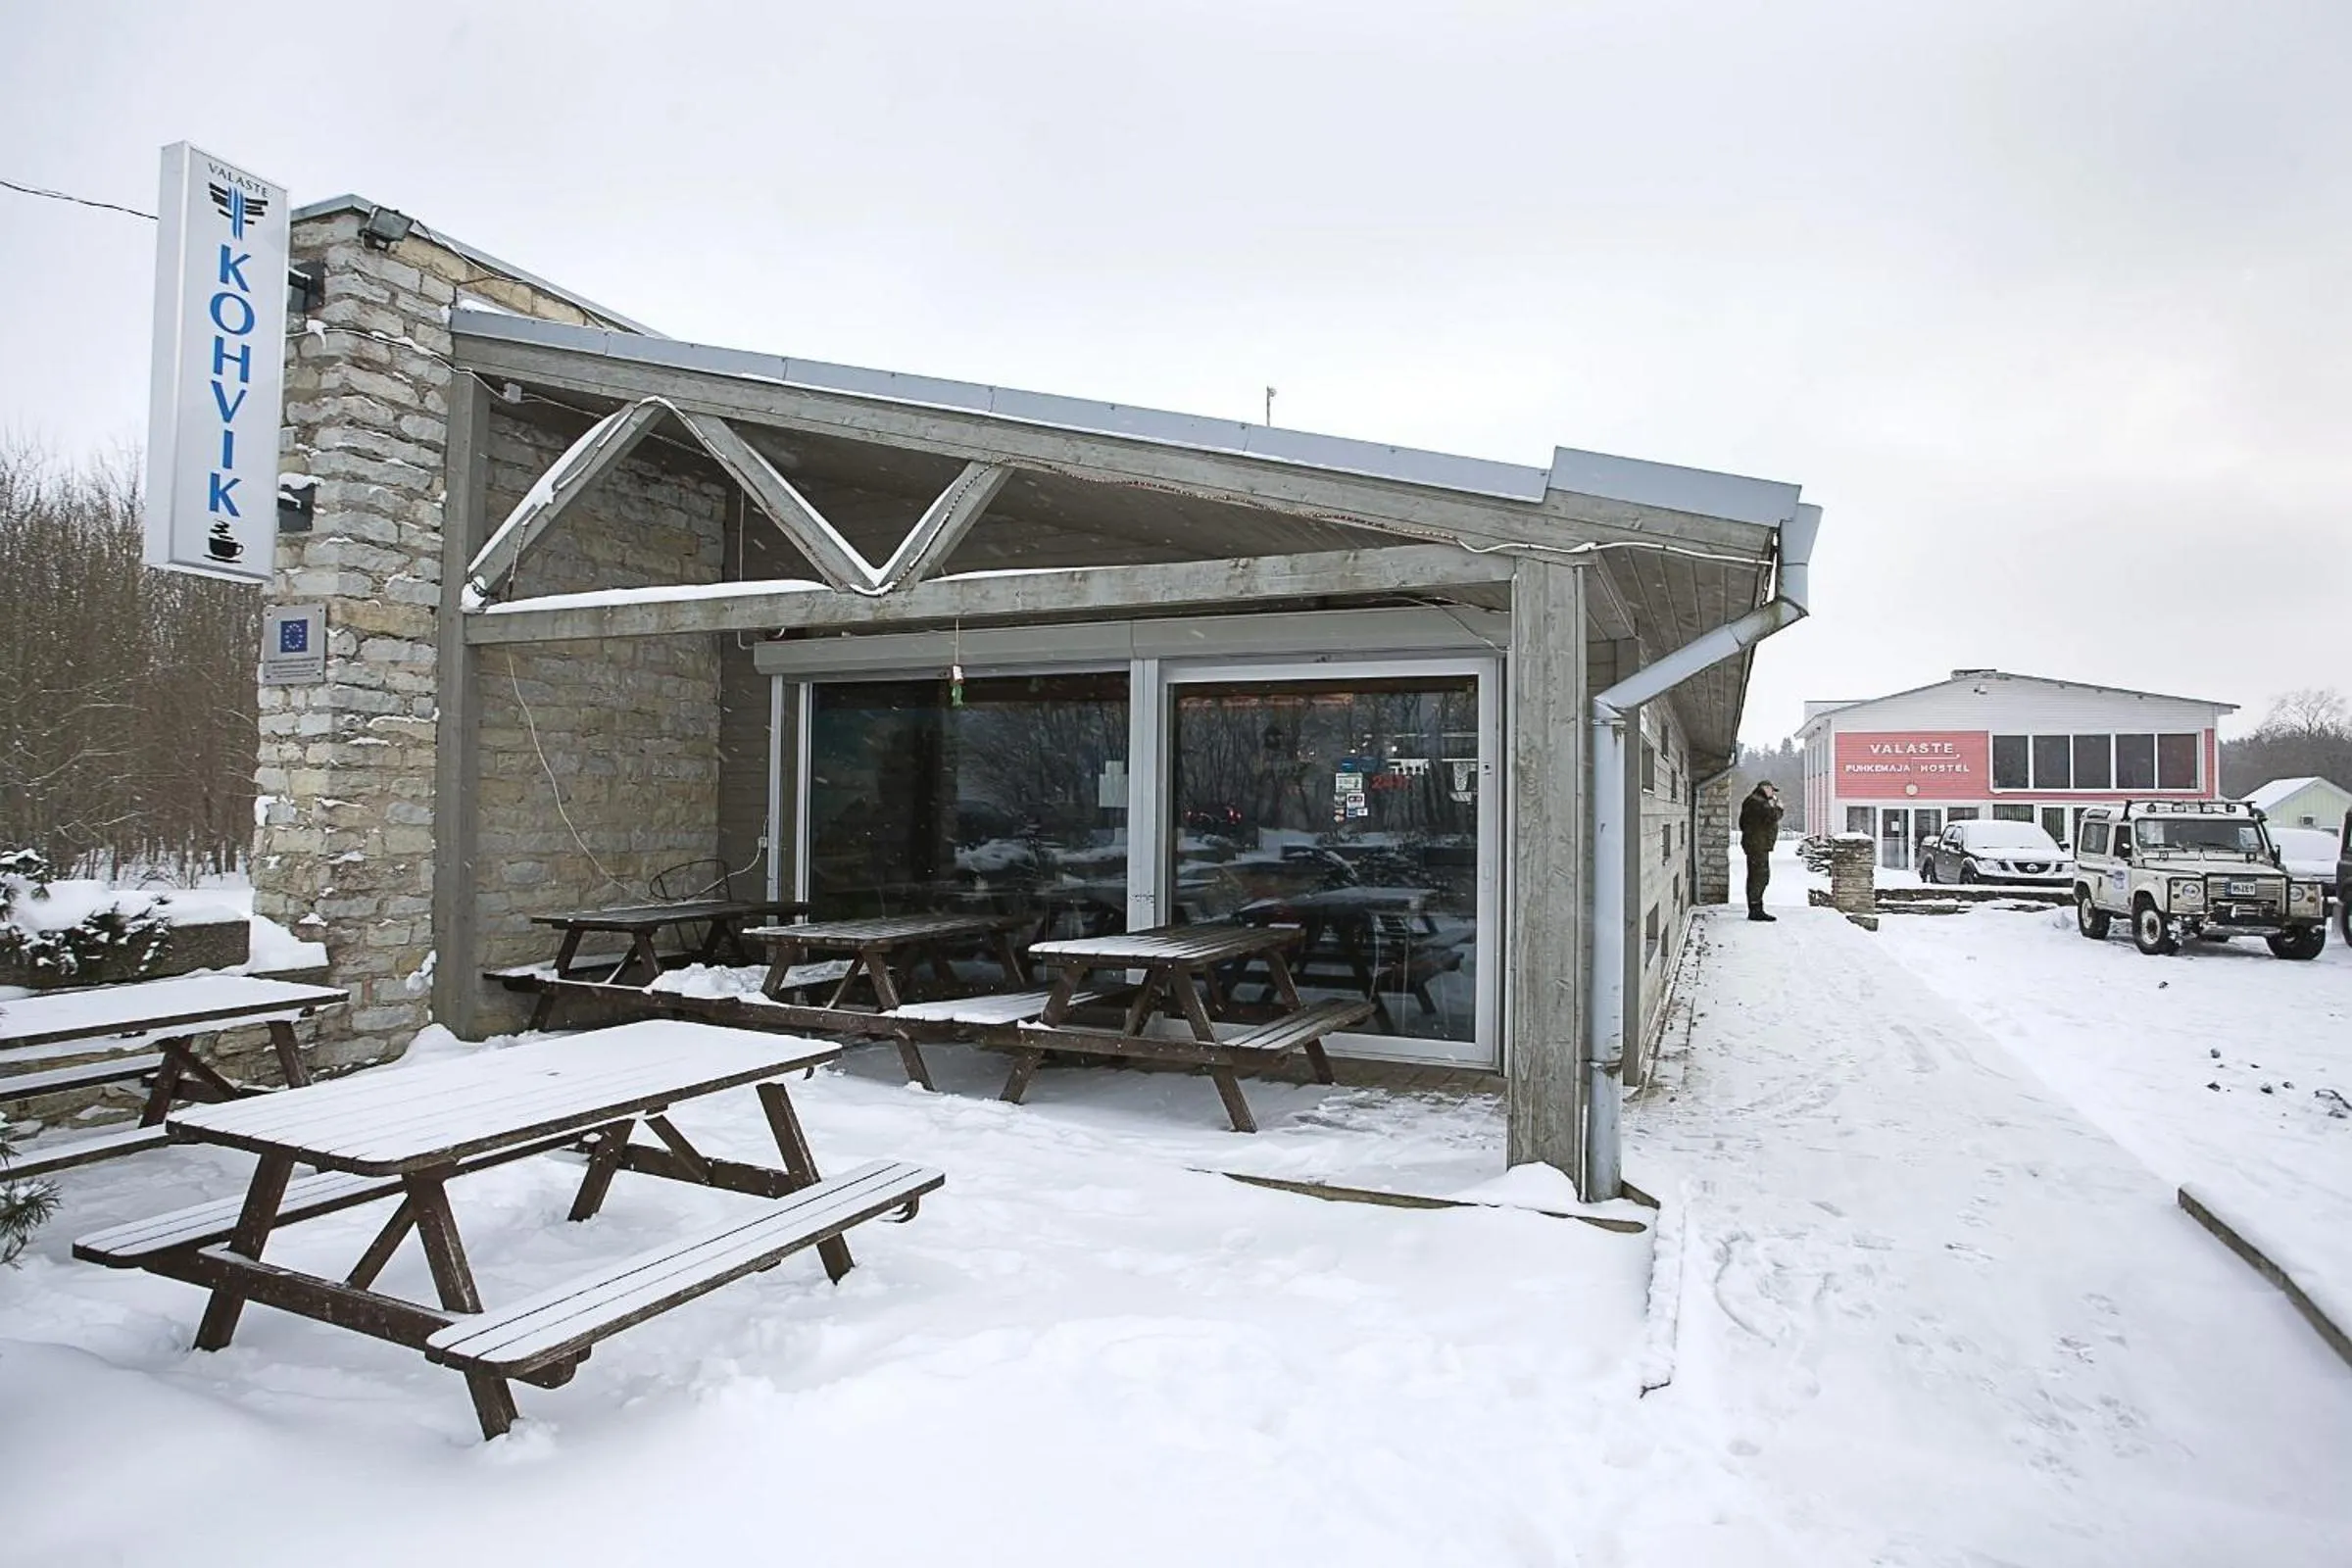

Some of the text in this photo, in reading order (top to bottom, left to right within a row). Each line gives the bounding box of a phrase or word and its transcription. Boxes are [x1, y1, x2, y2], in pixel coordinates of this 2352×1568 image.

[208, 162, 268, 198] VALASTE
[208, 244, 256, 517] KOHVIK
[1869, 743, 1954, 755] VALASTE
[1844, 763, 1971, 773] PUHKEMAJA HOSTEL
